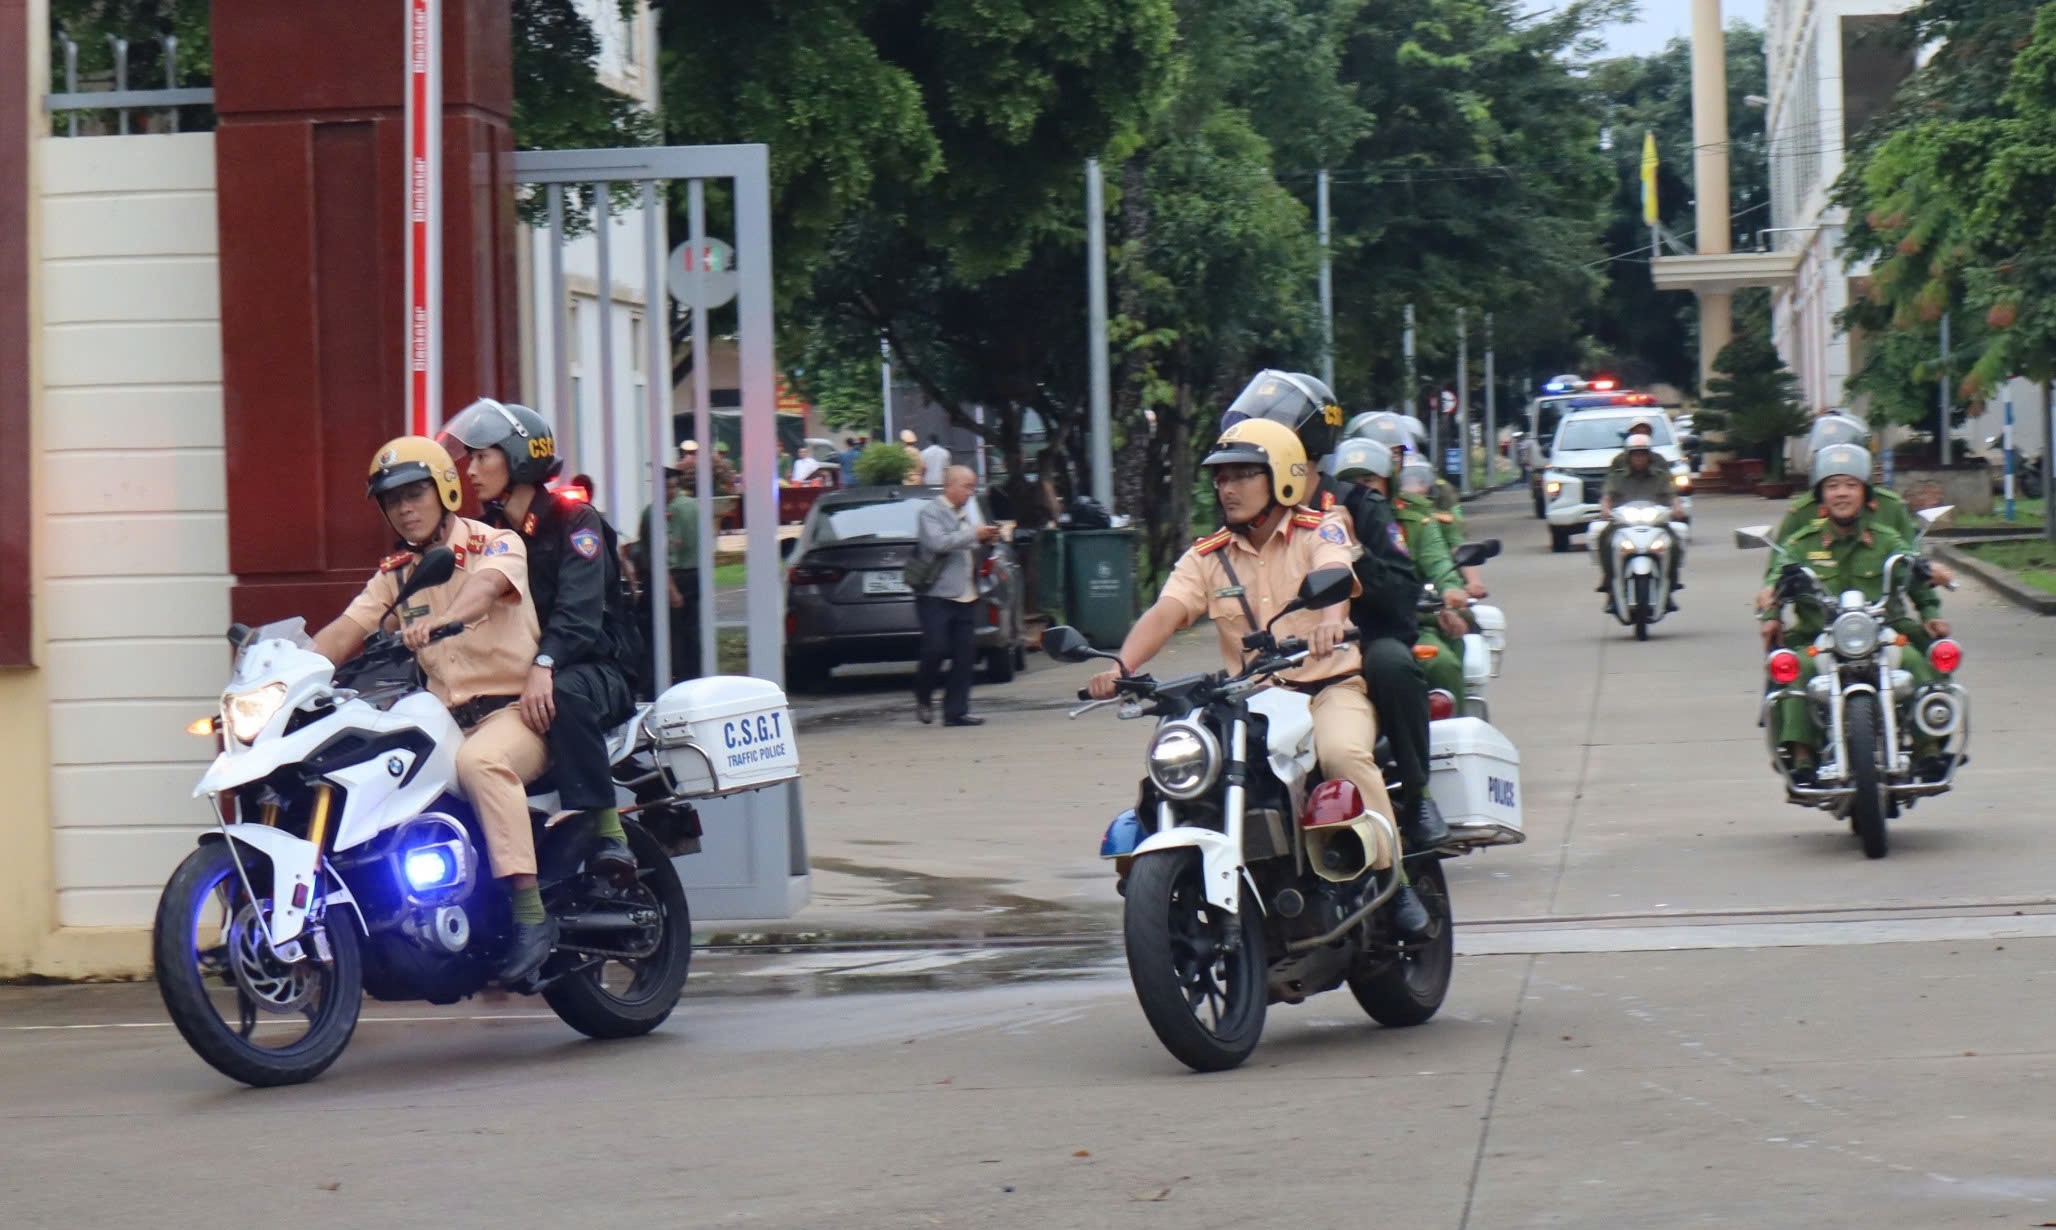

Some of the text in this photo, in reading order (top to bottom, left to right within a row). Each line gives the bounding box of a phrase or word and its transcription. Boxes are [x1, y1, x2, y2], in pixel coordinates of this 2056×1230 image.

[723, 711, 781, 749] C.S.G.T
[727, 743, 786, 768] TRAFFIC POLICE
[1487, 775, 1515, 809] POLICE
